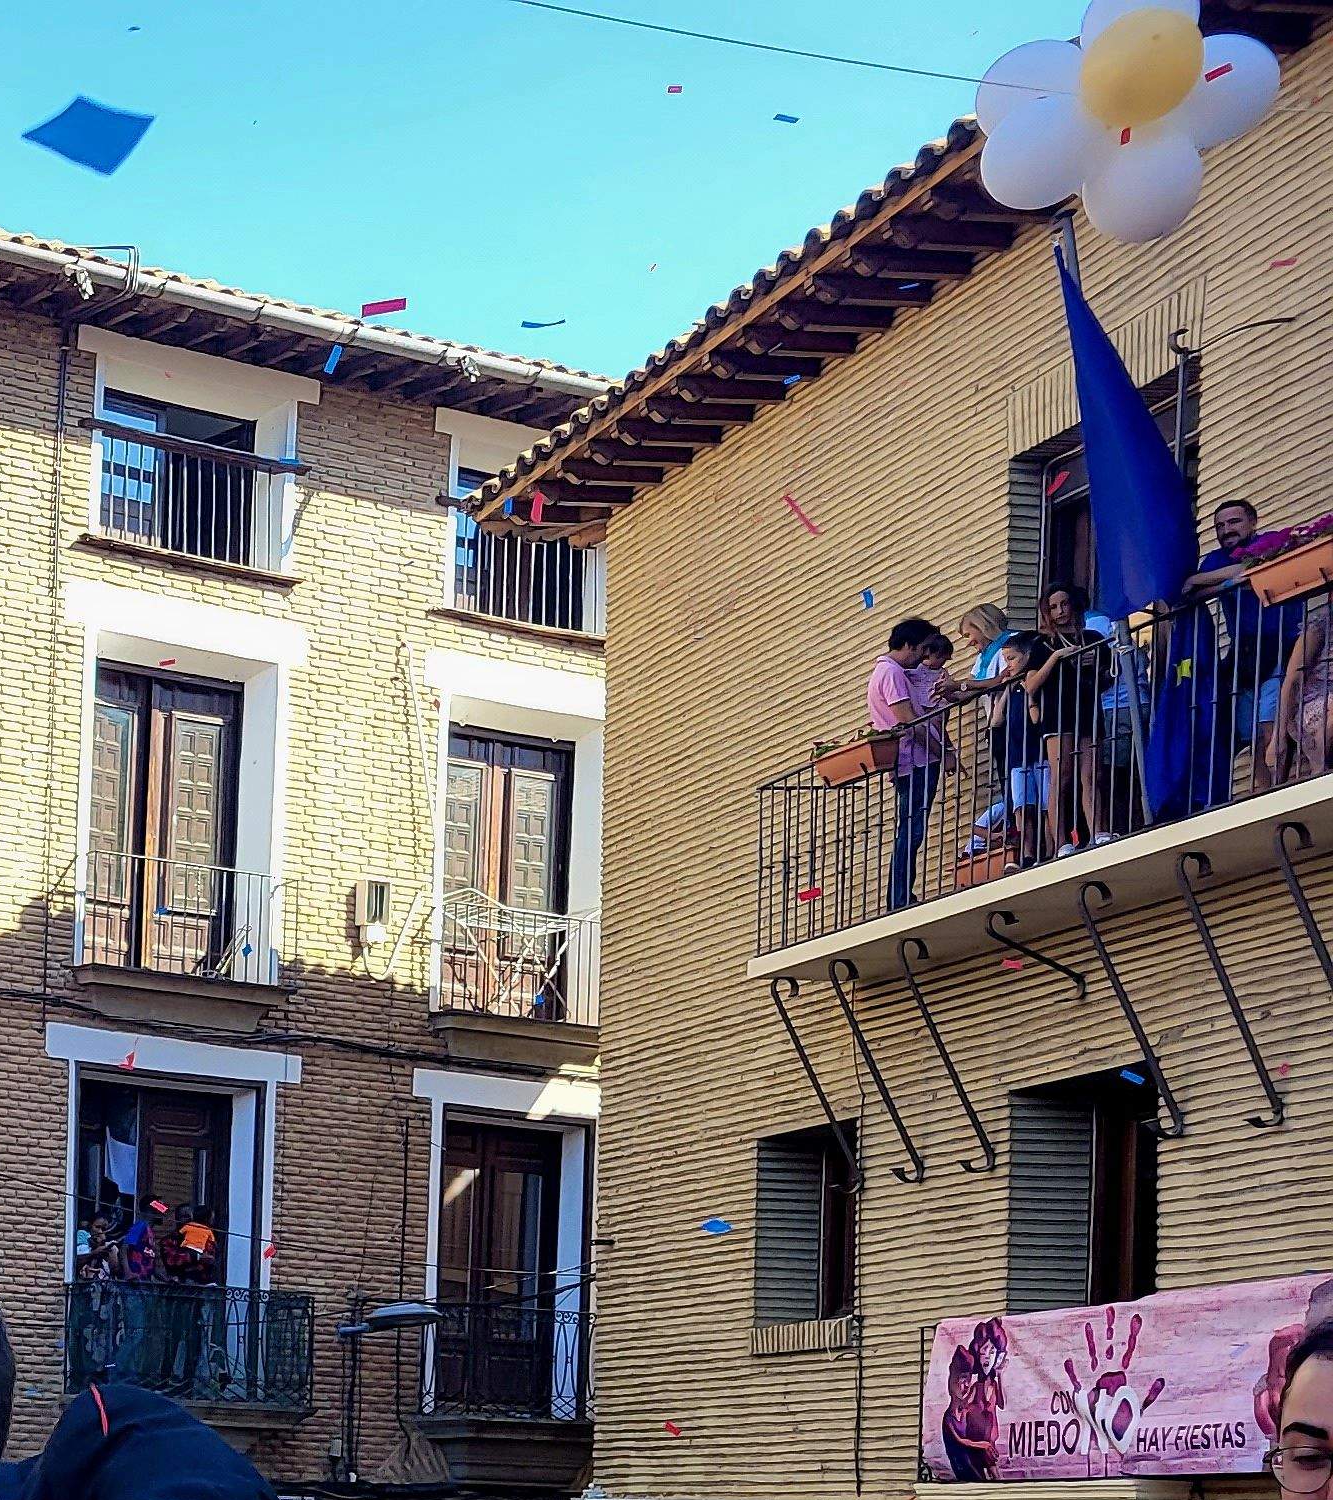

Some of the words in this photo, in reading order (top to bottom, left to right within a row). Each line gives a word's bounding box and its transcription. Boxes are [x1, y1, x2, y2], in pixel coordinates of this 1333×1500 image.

[1008, 1418, 1081, 1459] MIEDO
[1075, 1385, 1141, 1456] NO
[1136, 1426, 1170, 1453] HAY
[1175, 1421, 1246, 1451] FIESTAS
